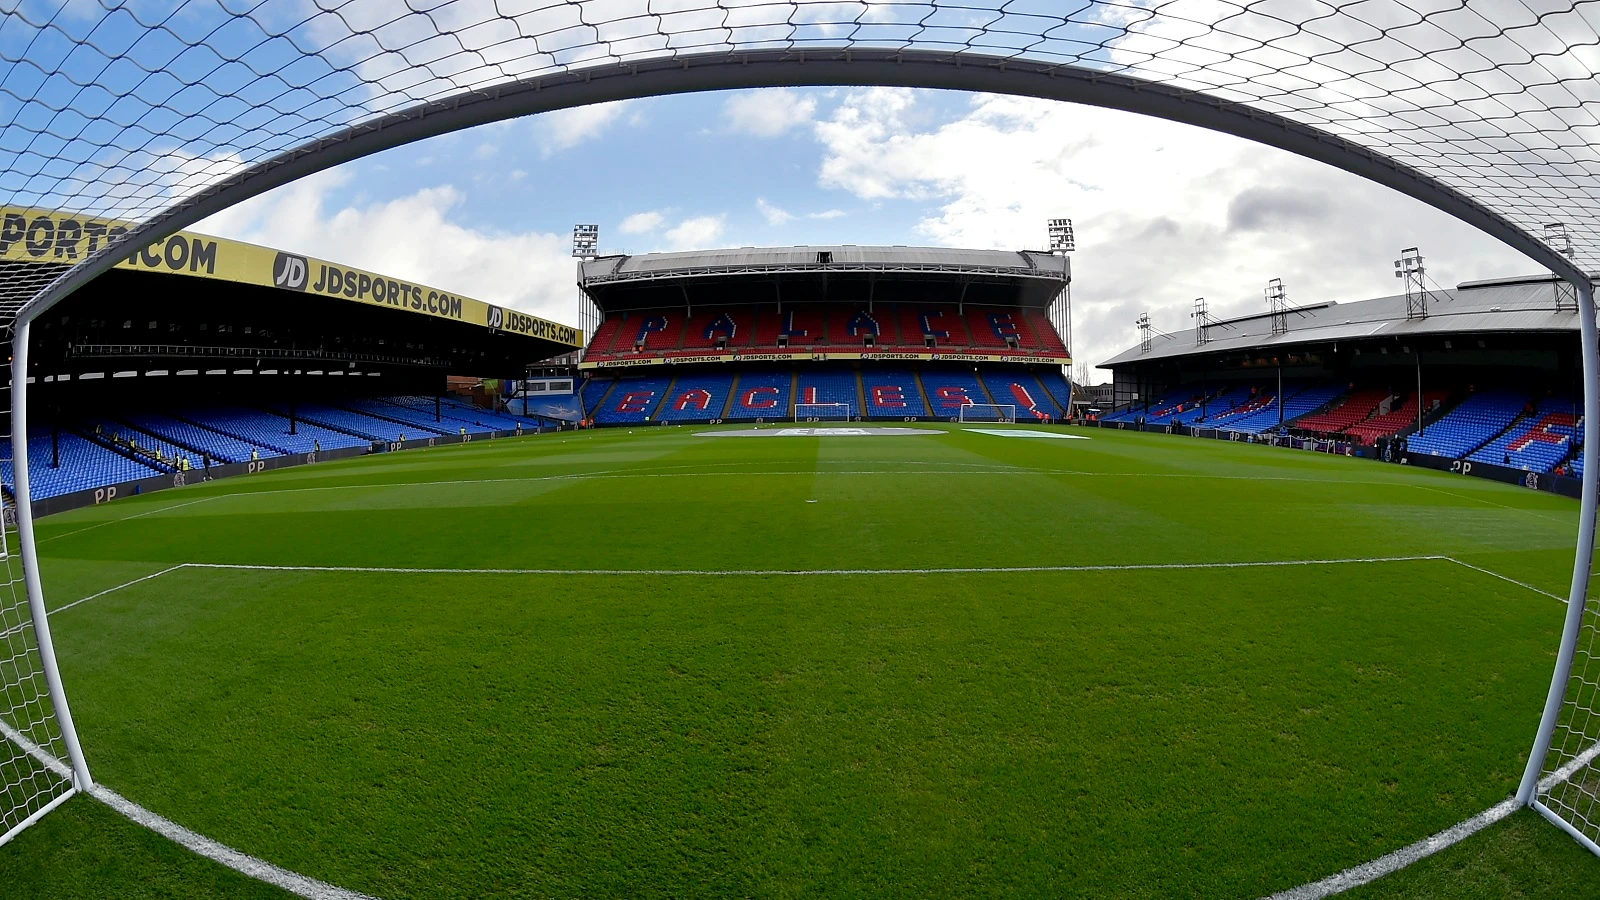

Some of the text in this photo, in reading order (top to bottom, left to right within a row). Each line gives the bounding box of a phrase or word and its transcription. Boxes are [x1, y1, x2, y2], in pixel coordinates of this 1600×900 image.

[276, 256, 462, 318] JD JDSPORTS.COM
[488, 305, 576, 345] JD JDSPORTS.COM
[606, 359, 652, 367] JDSPORTS.COM
